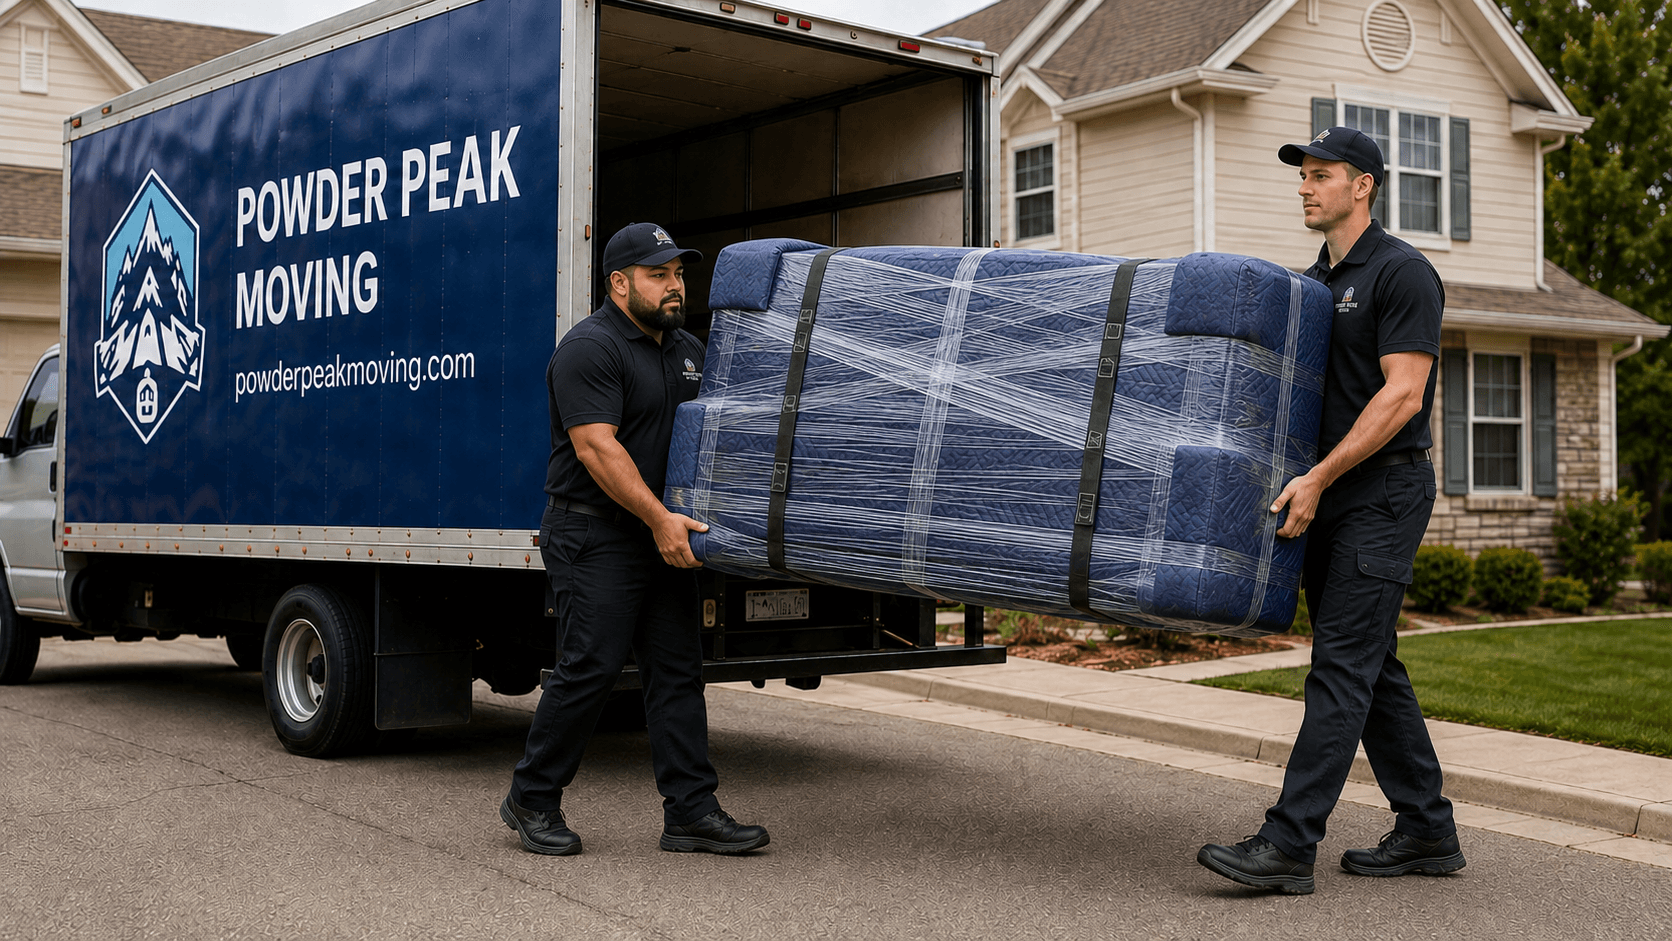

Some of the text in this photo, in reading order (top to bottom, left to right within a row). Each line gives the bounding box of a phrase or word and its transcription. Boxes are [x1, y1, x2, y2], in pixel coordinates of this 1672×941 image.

[237, 125, 520, 247] POWDER PEAK
[237, 251, 377, 329] MOVING
[236, 351, 474, 402] powderpeakmoving.com
